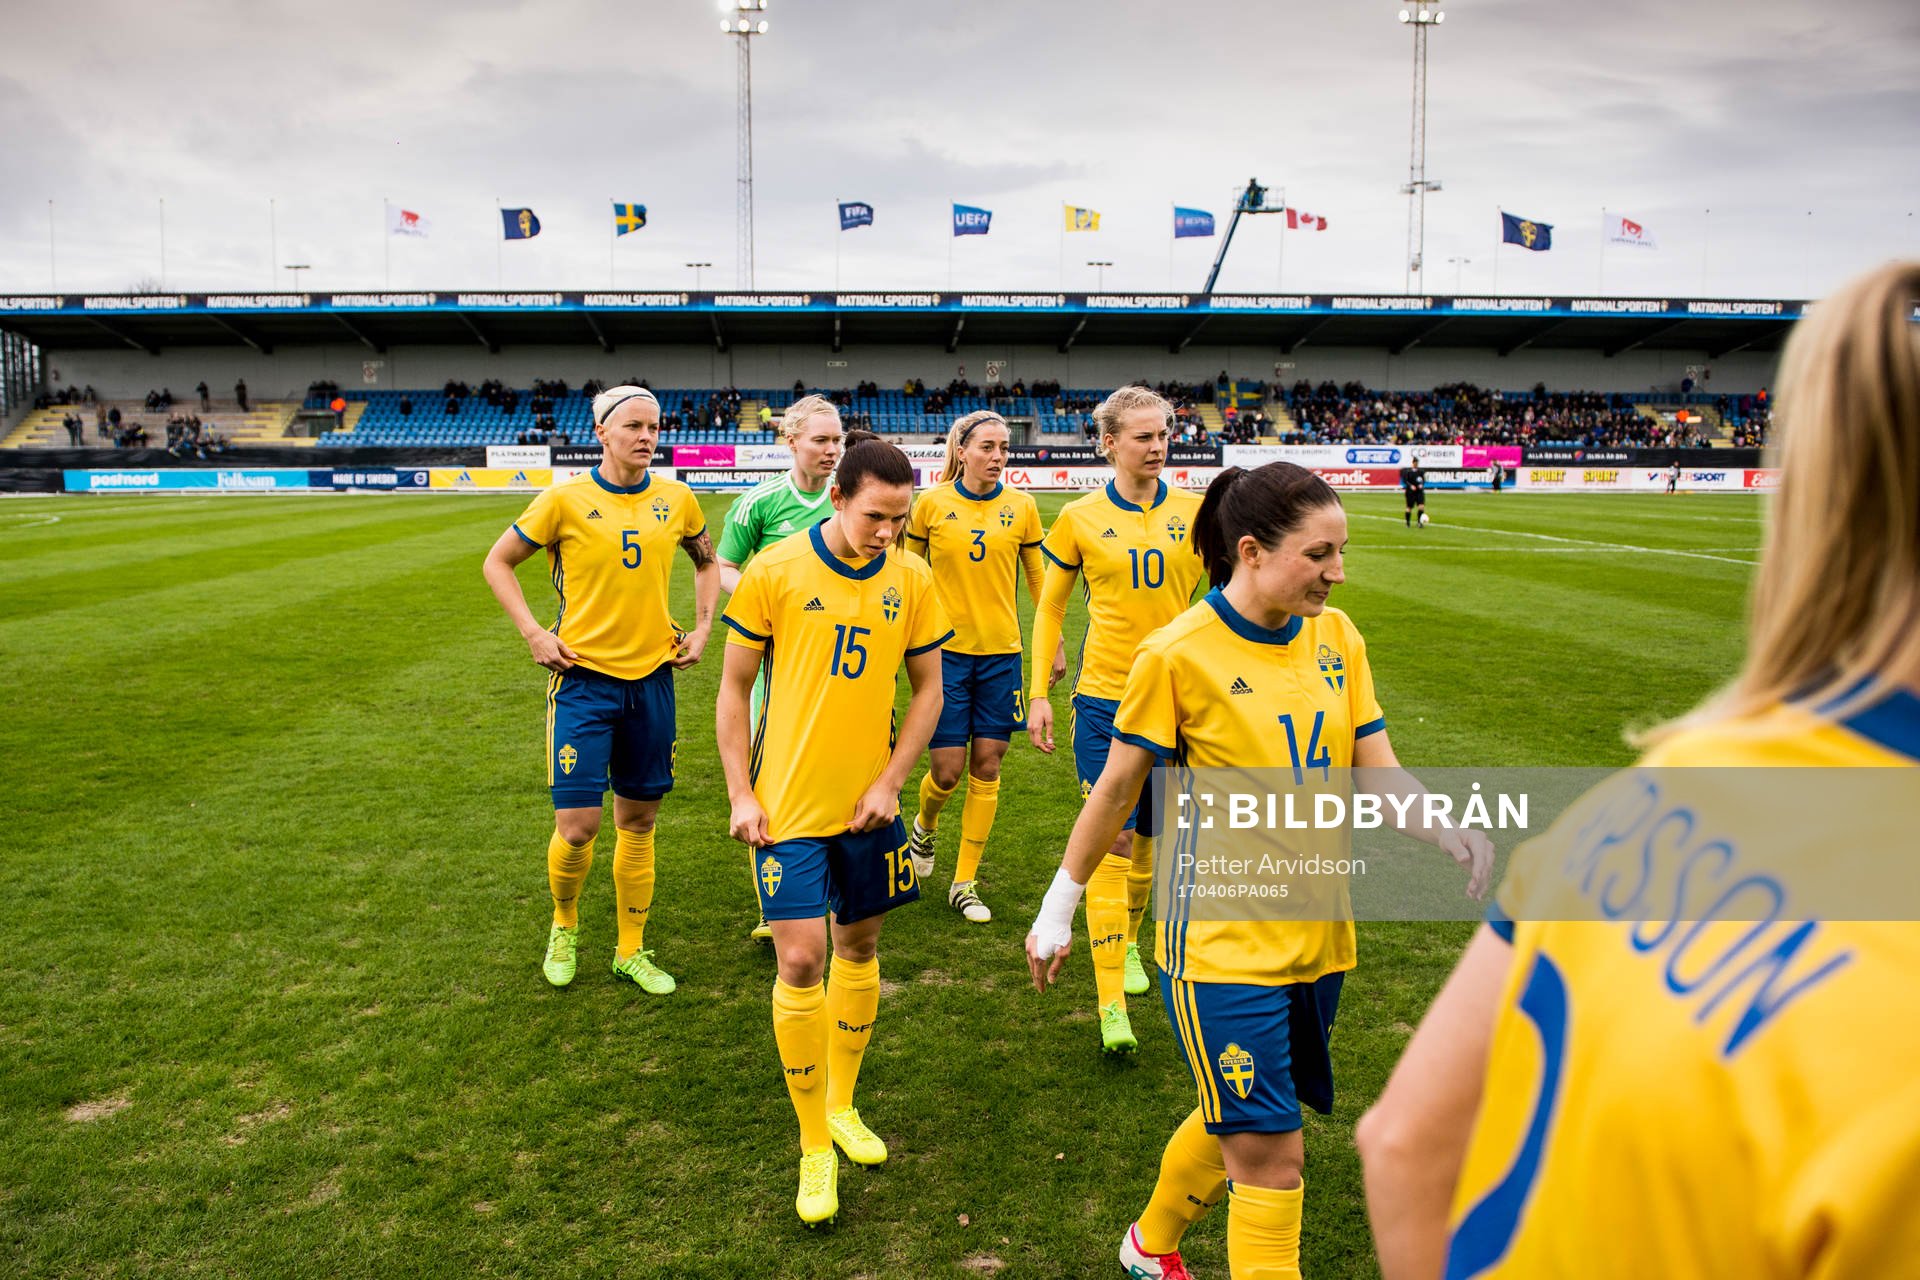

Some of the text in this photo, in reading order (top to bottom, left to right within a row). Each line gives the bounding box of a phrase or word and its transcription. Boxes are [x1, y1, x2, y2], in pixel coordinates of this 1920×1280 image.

[844, 206, 868, 218] FIFA
[955, 213, 988, 225] UEFA
[0, 297, 54, 310] LSPORTEN
[84, 296, 178, 309] NATIONALSPORTEN
[207, 295, 302, 308] NATIONALSPORTEN
[332, 294, 426, 307] NATIONALSPORTEN
[457, 294, 551, 307] NATIONALSPORTEN
[584, 294, 680, 306] NATIONALSPORTEN
[714, 295, 803, 306] NATIONALSPORTEN
[836, 294, 931, 306] NATIONALSPORTEN
[961, 294, 1056, 307] NATIONALSPORTEN
[1086, 295, 1180, 308] NATIONALSPORTEN
[1210, 296, 1302, 309] NATIONALSPORTEN
[1332, 297, 1424, 310] NATIONALSPORTEN
[1452, 298, 1543, 311] NATIONALSPORTEN
[1571, 299, 1660, 313] NATIONALSPORTEN
[1688, 301, 1775, 314] NATIONALSPORTEN
[556, 453, 573, 461] ALLA
[574, 451, 584, 460] ÄR
[1072, 451, 1081, 459] ÄR
[1193, 452, 1203, 460] ÄR
[90, 473, 159, 487] postnord
[217, 471, 276, 487] Folksam
[332, 473, 398, 485] MADE BY SWEDEN
[1005, 470, 1032, 484] ICA
[1530, 470, 1566, 482] SPORT
[1583, 470, 1619, 482] SPORT
[1660, 472, 1726, 482] INERSPORT
[622, 530, 642, 569] 5
[969, 529, 986, 562] 3
[1128, 548, 1165, 589] 10
[831, 624, 871, 680] 15
[1230, 687, 1253, 695] adidas
[1013, 690, 1024, 722] 3
[1278, 711, 1331, 785] 14
[885, 842, 915, 898] 15
[1092, 933, 1124, 948] SvFF
[783, 1064, 815, 1076] vFF
